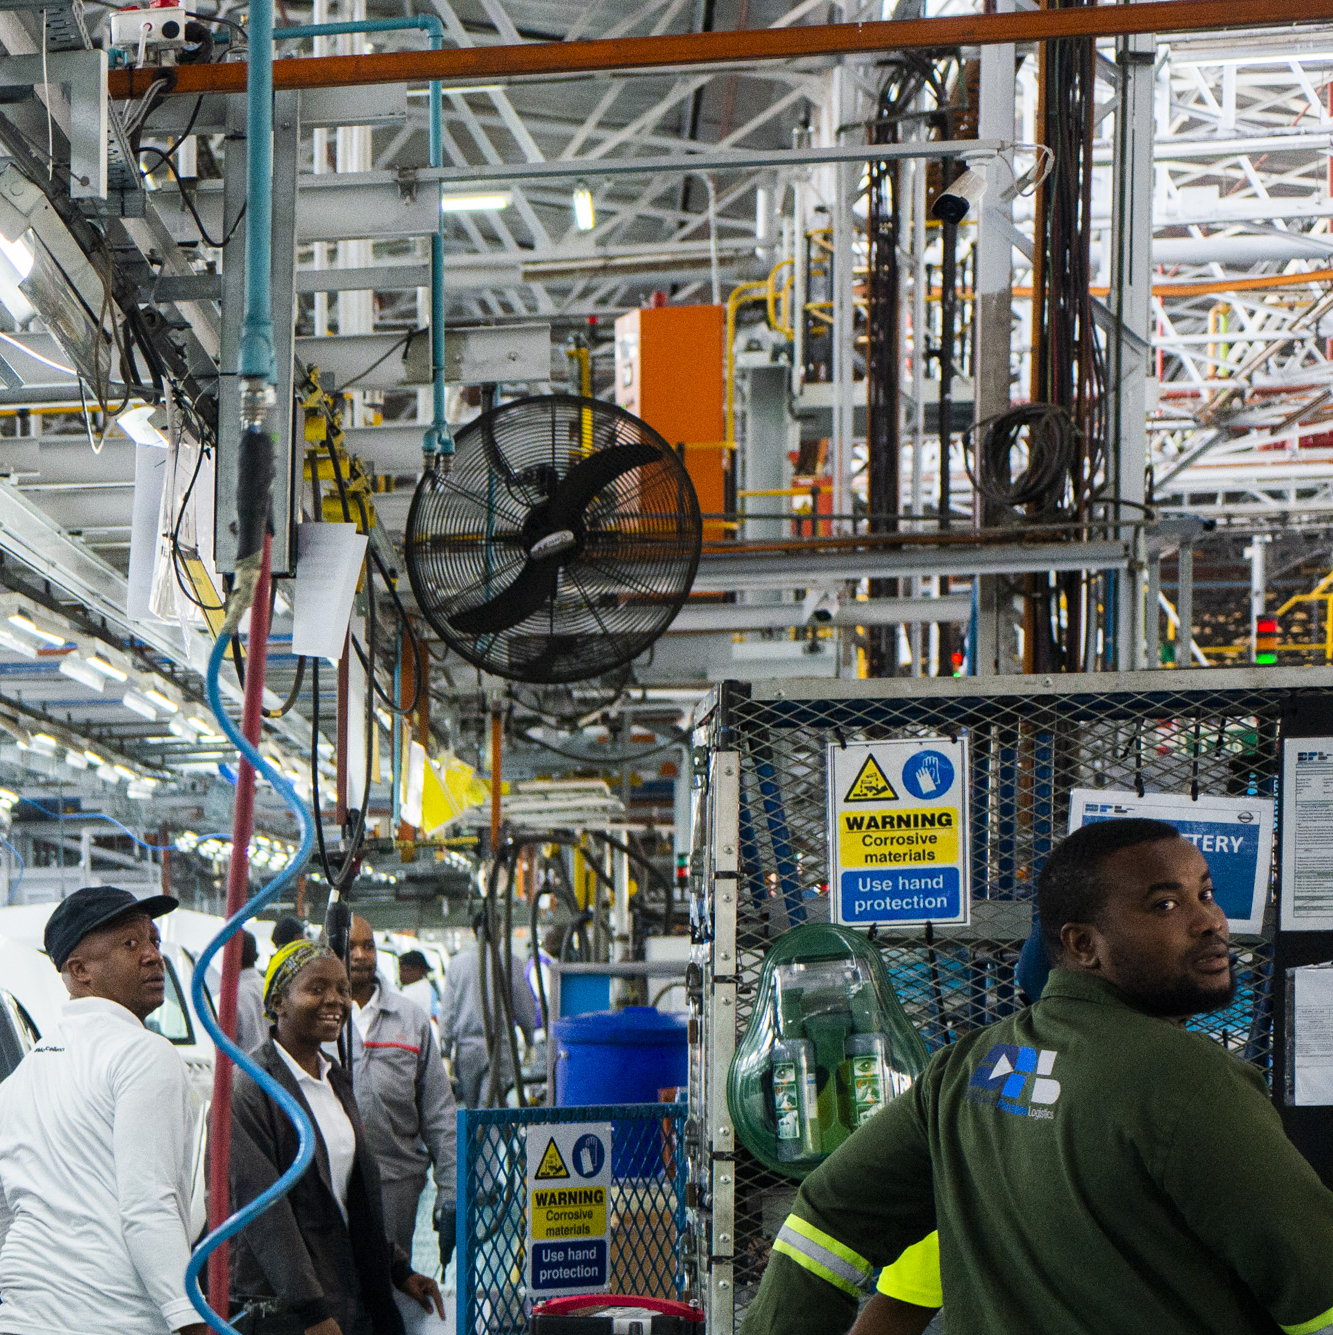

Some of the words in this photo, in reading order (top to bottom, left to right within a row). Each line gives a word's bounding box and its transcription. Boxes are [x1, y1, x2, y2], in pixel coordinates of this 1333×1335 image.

[845, 812, 953, 831] WARNING
[862, 832, 938, 847] Corrosive
[1181, 833, 1244, 853] TERY
[864, 849, 936, 864] materials
[858, 877, 893, 892] Use
[898, 875, 944, 891] hand
[854, 894, 948, 914] protection
[1028, 1106, 1054, 1120] Logistics
[535, 1189, 604, 1206] WARNING
[546, 1208, 594, 1221] Corrosive
[545, 1223, 591, 1237] materials
[542, 1248, 565, 1262] Use
[568, 1246, 597, 1261] hand
[539, 1264, 599, 1283] protection
